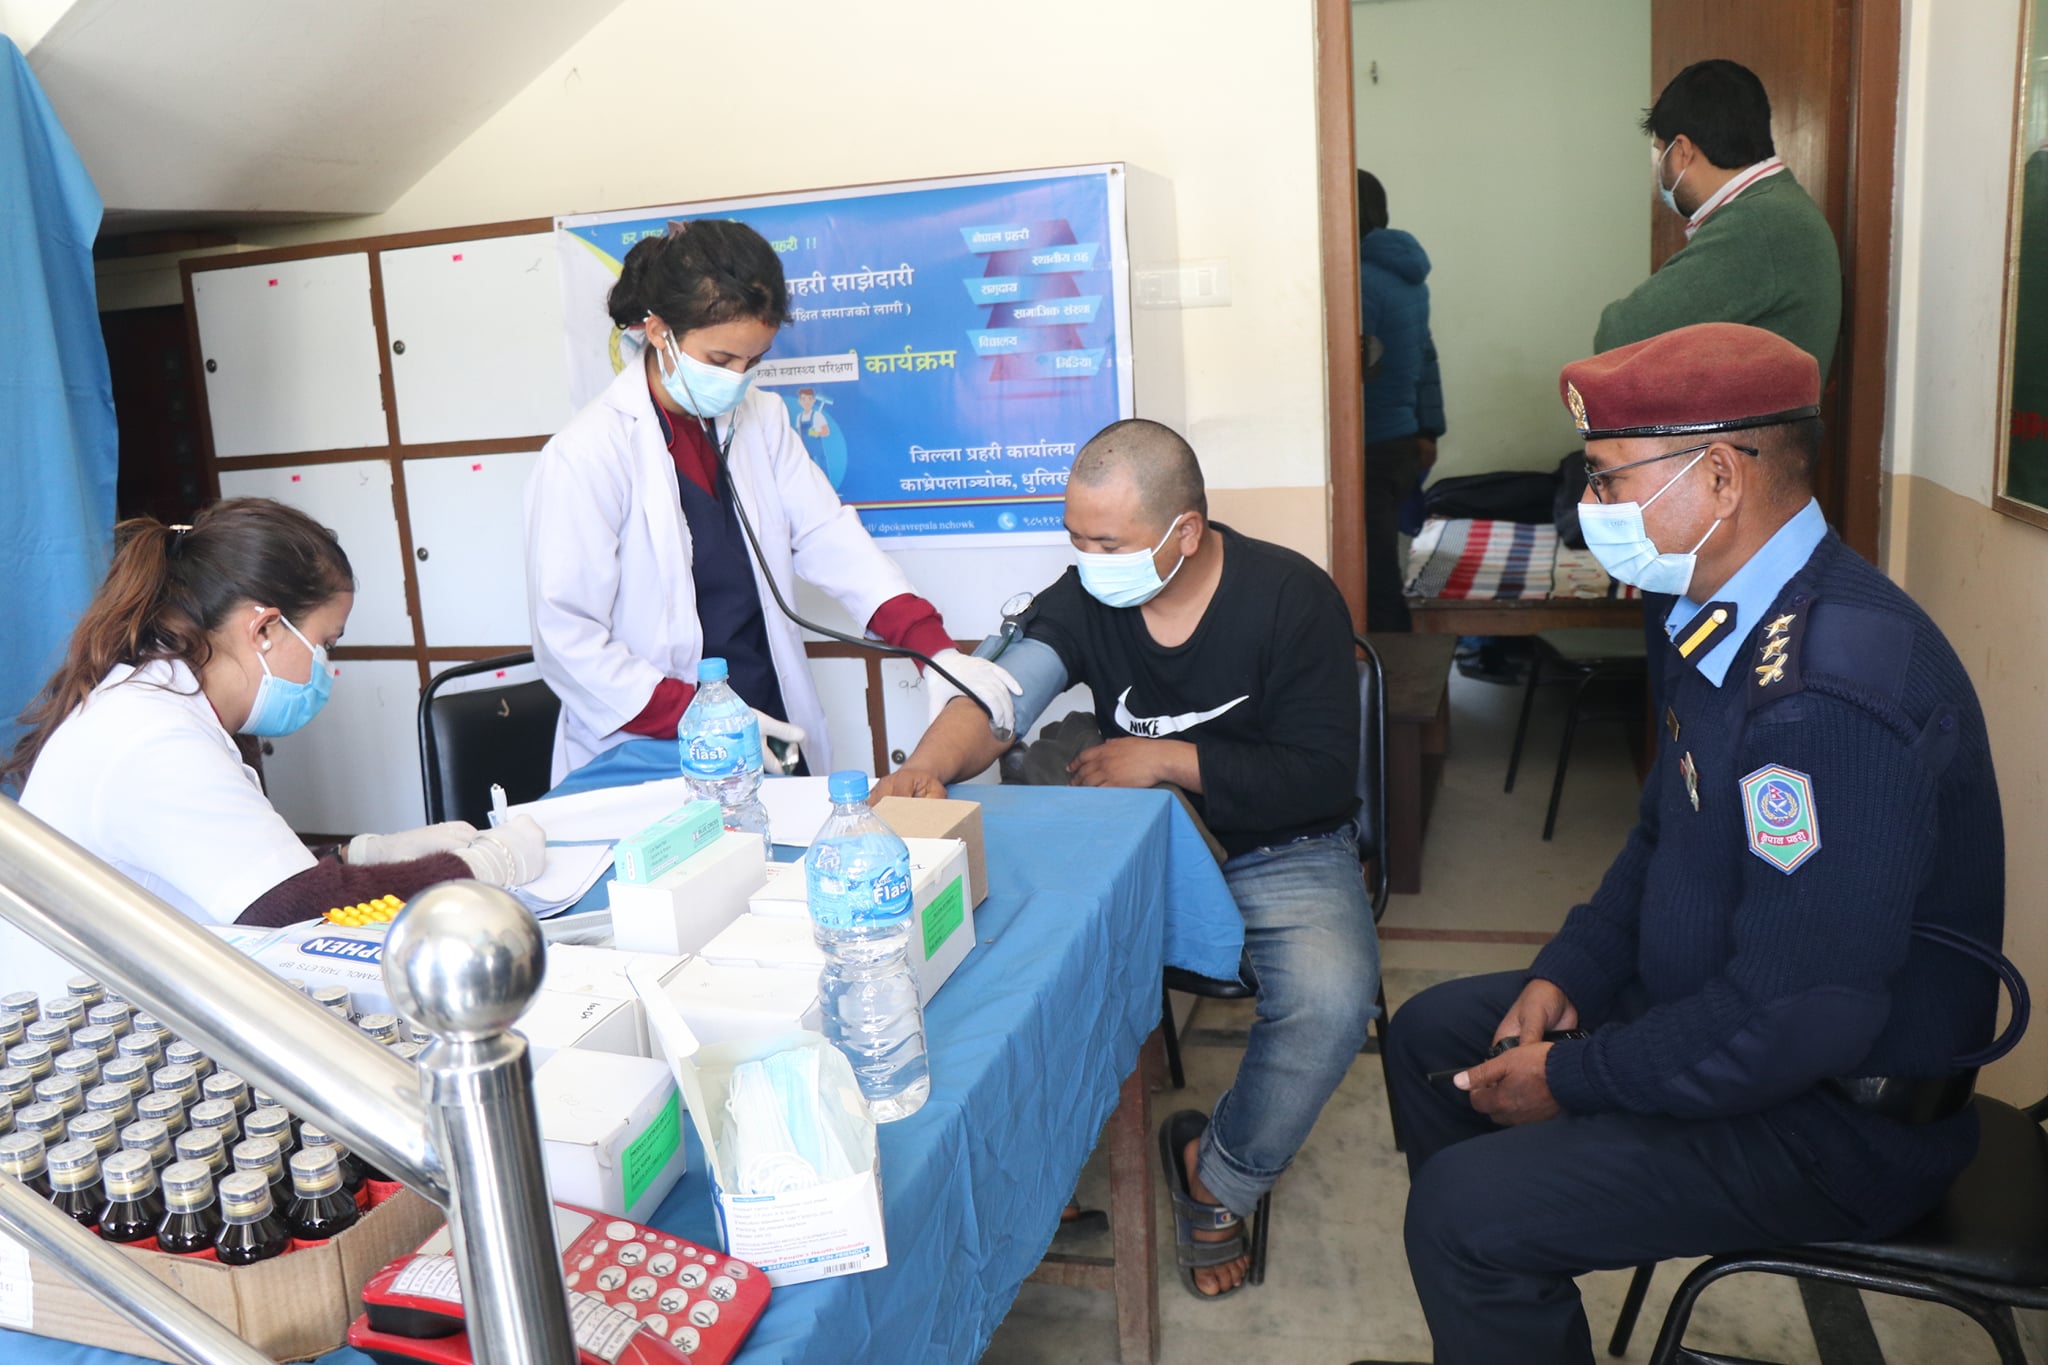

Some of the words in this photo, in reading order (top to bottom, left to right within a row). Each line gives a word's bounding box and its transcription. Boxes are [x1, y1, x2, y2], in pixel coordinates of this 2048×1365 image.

[1004, 227, 1031, 242] प्रहरी
[831, 262, 915, 292] साझेदारी
[821, 302, 871, 320] समाजको
[873, 300, 904, 316] लागी
[863, 345, 958, 375] कार्यक्रम
[910, 445, 963, 464] जिल्ला
[966, 442, 1003, 462] प्रहरी
[1006, 438, 1077, 459] कार्यालय
[1129, 720, 1160, 736] NIKE
[689, 745, 728, 760] Flash
[872, 874, 912, 904] Flash
[621, 1252, 641, 1265] 3
[652, 1262, 669, 1275] 6
[600, 1274, 618, 1288] 2
[681, 1272, 698, 1287] 9
[631, 1285, 650, 1300] 5
[661, 1297, 680, 1312] 8
[693, 1311, 713, 1325] 0
